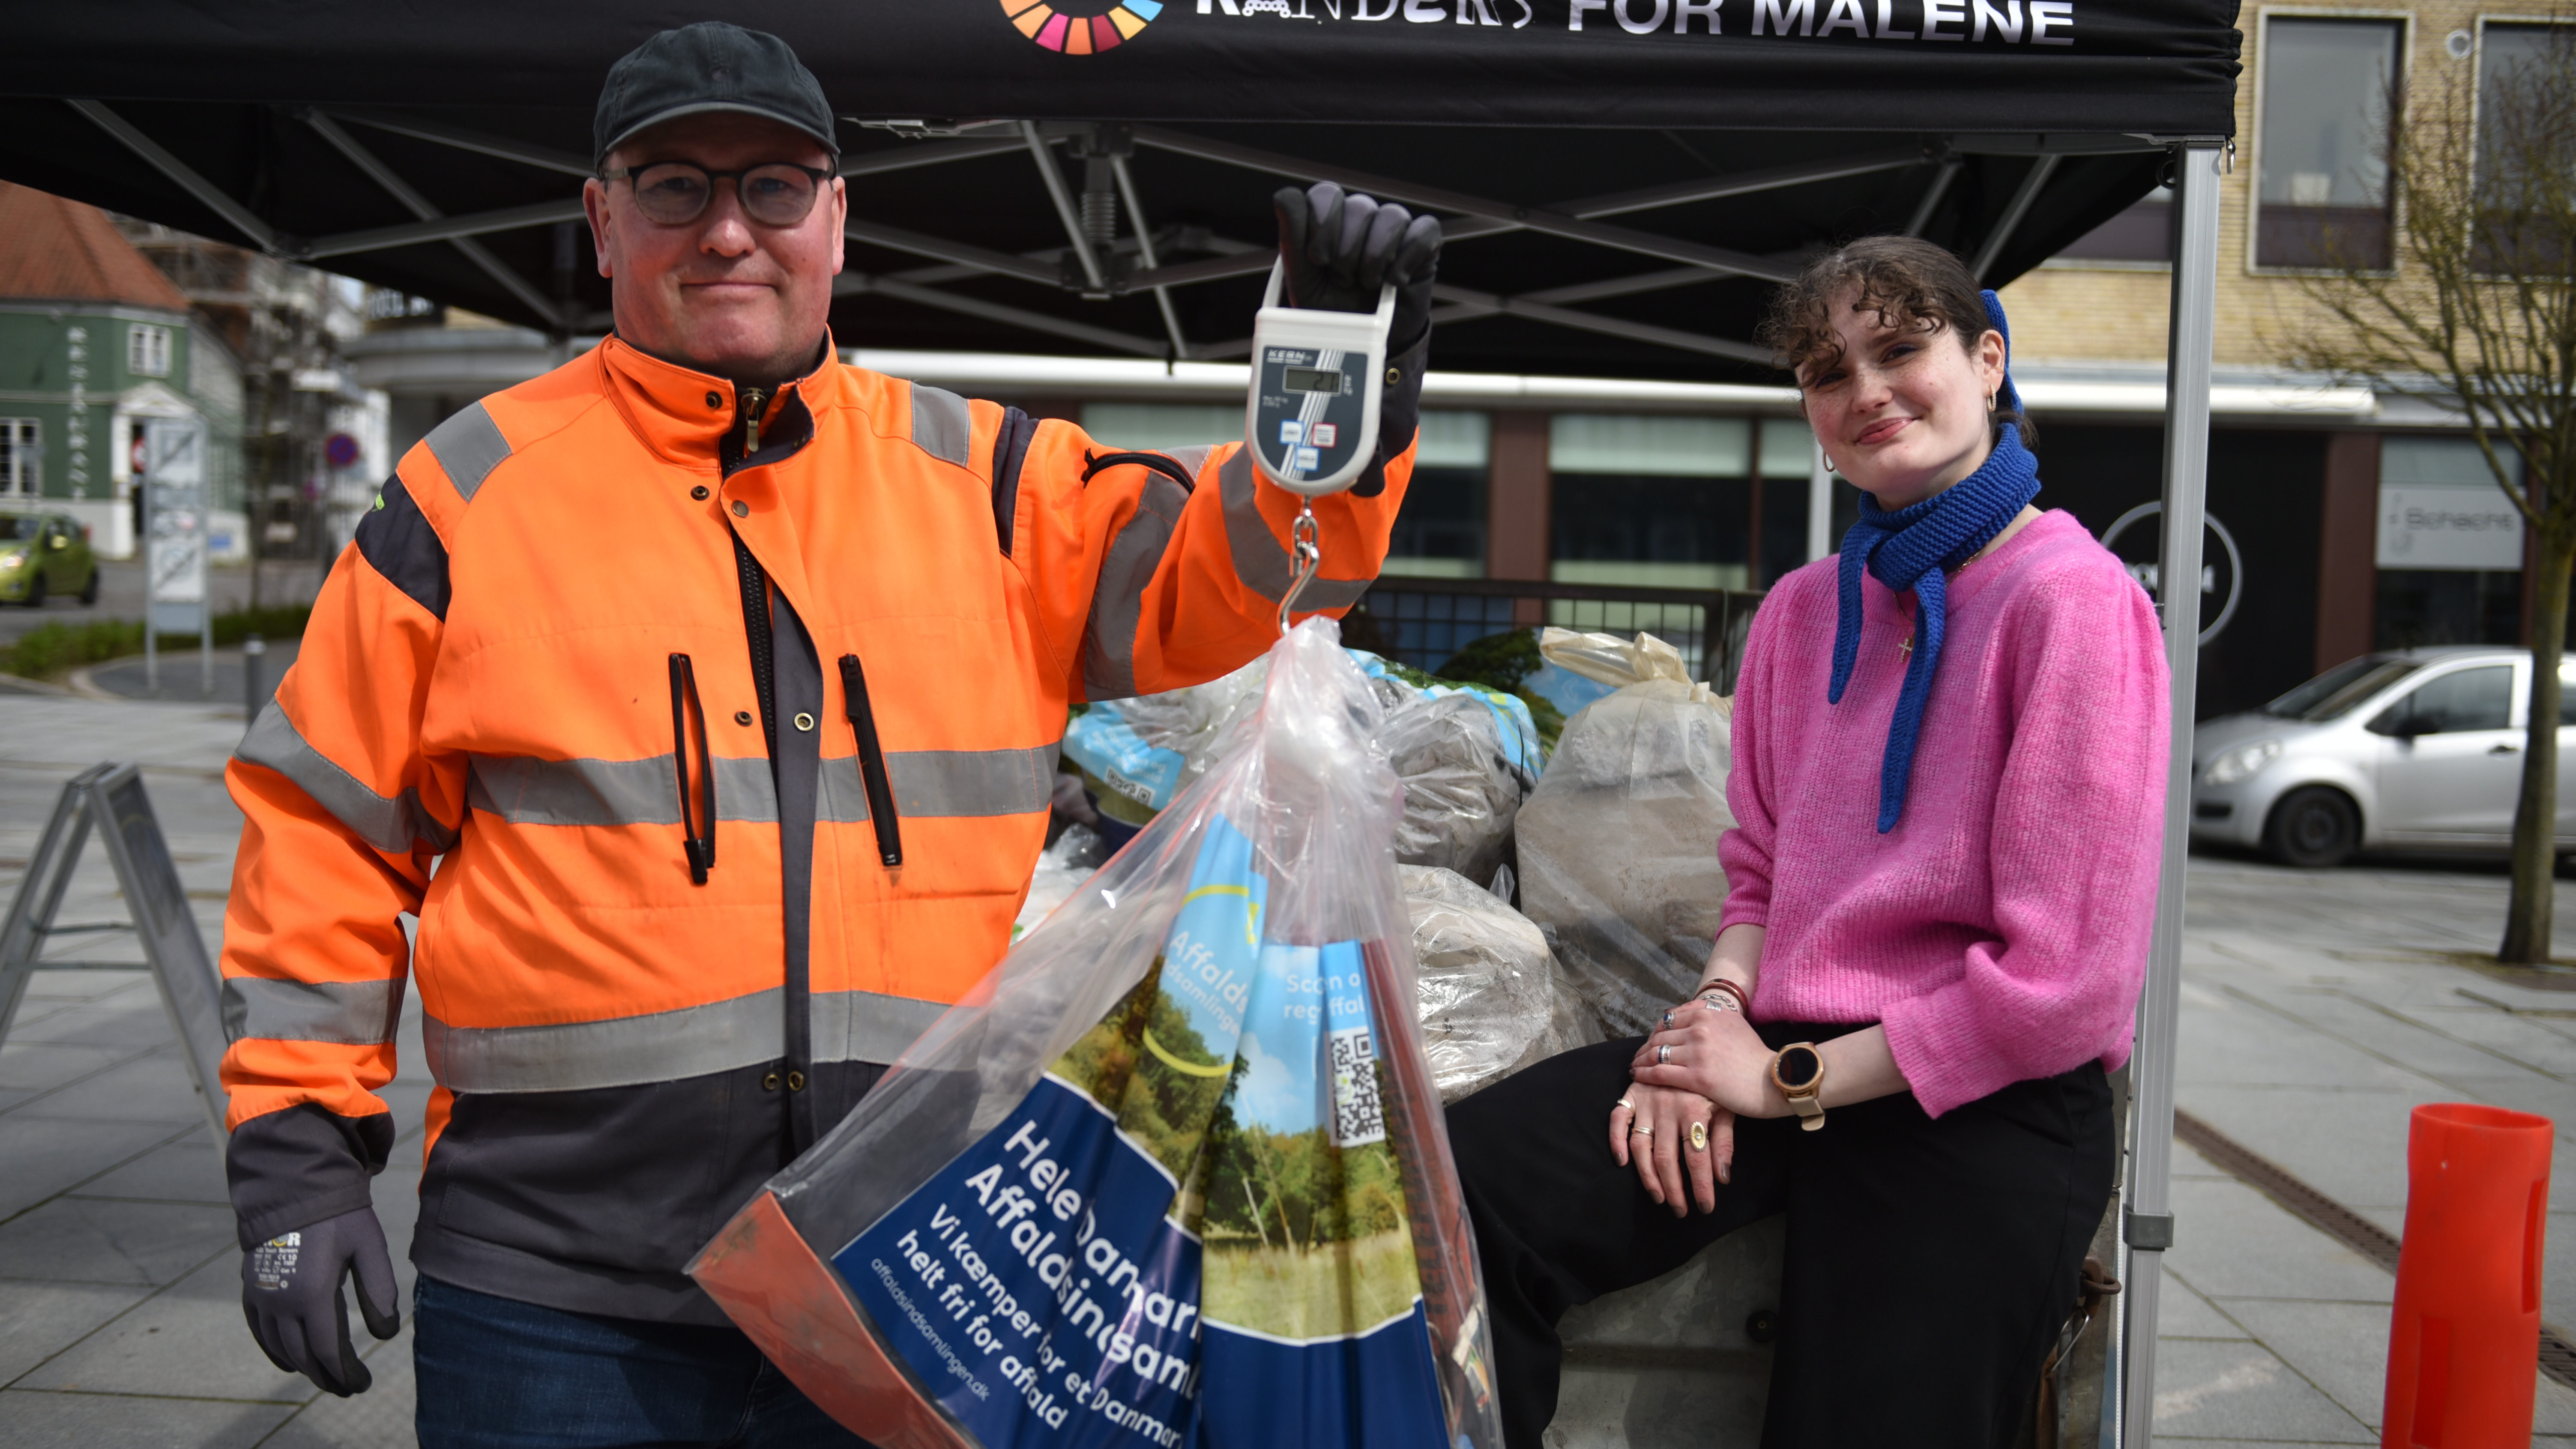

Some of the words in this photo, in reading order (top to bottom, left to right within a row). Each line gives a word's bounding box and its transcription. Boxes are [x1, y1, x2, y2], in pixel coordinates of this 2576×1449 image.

[1568, 0, 1721, 35] FOR
[1751, 0, 2074, 46] MALENE
[1268, 350, 1305, 360] KERN
[2405, 507, 2514, 532] Schacht
[1169, 931, 1248, 1014] Affalds
[1284, 1004, 1321, 1025] reg
[1329, 994, 1365, 1017] ffal
[1004, 1120, 1081, 1221] Hele
[871, 1258, 990, 1401] affaldsindsamlingen.dk
[897, 1229, 945, 1290] helt
[939, 1283, 976, 1321] fri
[965, 1314, 1003, 1355] for
[1000, 1355, 1069, 1430] affald
[930, 1203, 961, 1240] Vi
[948, 1231, 1041, 1339] kæmper
[1037, 1332, 1066, 1374] for
[1065, 1372, 1092, 1405] et
[1090, 1386, 1183, 1449] Danmar
